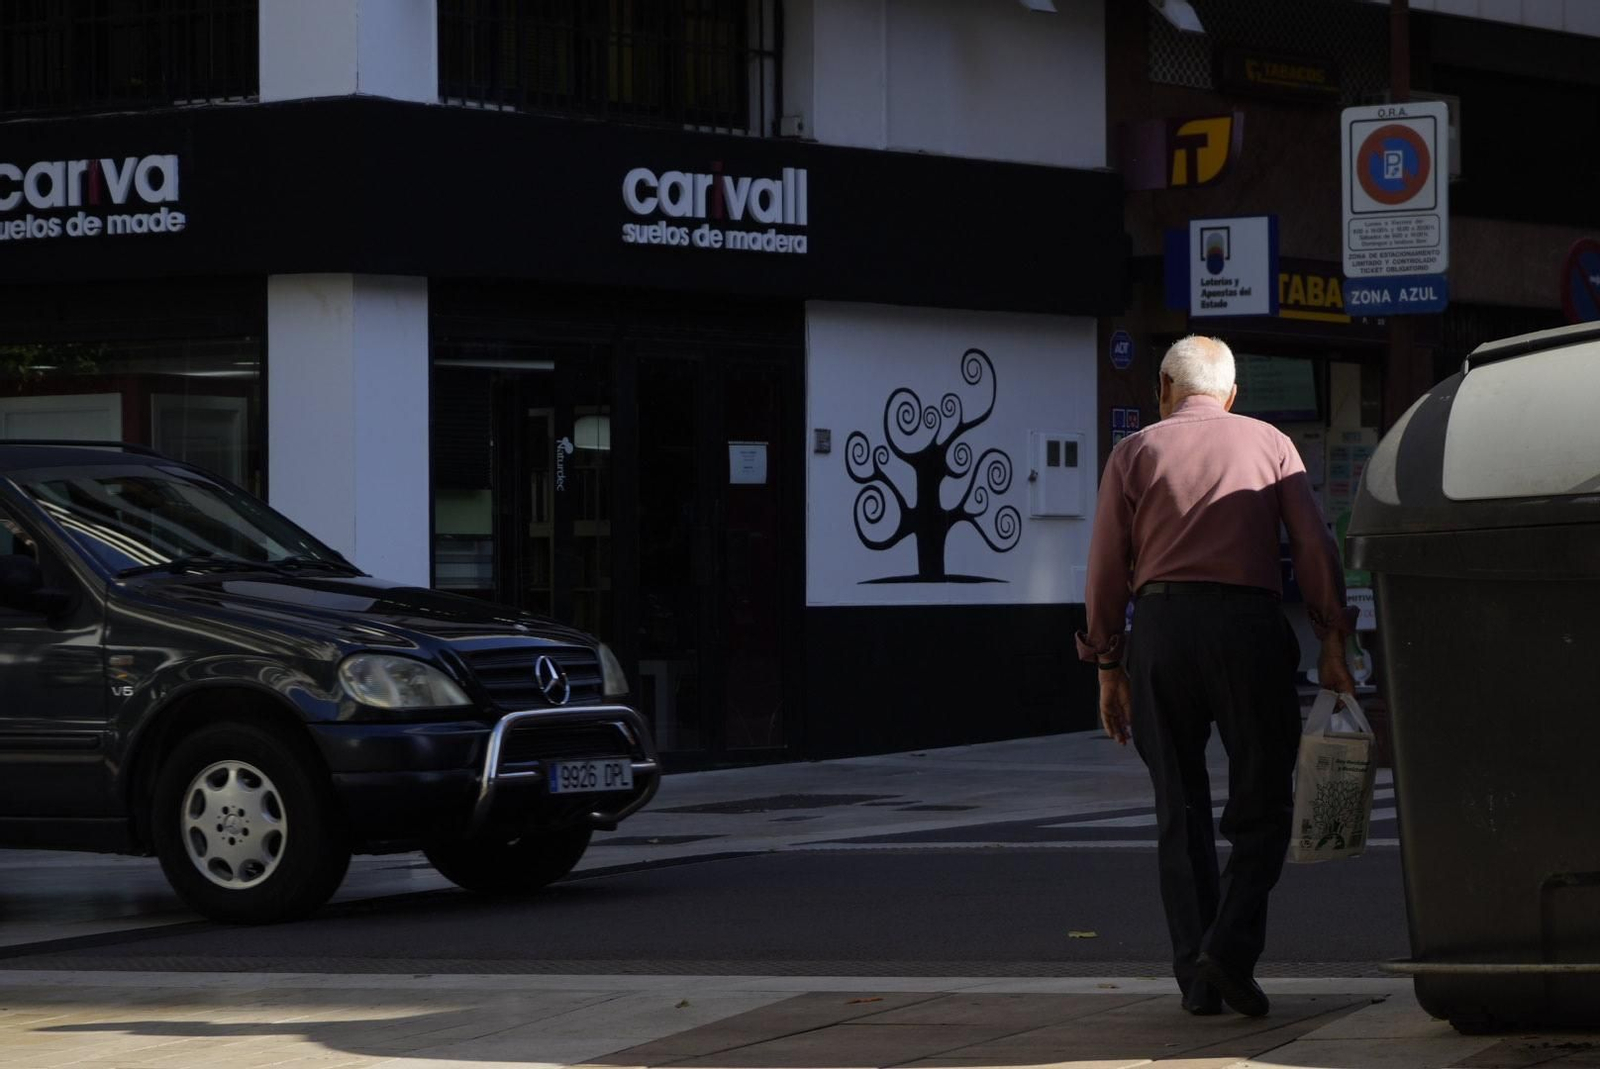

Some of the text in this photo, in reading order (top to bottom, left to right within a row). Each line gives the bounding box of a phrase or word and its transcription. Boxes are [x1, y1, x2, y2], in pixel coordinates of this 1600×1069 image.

[622, 160, 808, 227] carivall
[66, 211, 103, 237] de
[107, 206, 187, 235] made
[622, 220, 808, 256] suelos de madera
[1368, 251, 1379, 259] DE
[1379, 249, 1441, 259] ESTACIONAMIENTO
[1391, 257, 1438, 266] CONTROLADO
[1359, 264, 1430, 274] TICKET OBLIGATORIO
[1233, 277, 1240, 287] y
[1200, 285, 1252, 299] Apuestas del
[1351, 287, 1438, 305] ZONA AZUL
[1200, 298, 1228, 309] Estado
[110, 685, 135, 696] V6
[561, 763, 630, 789] 9926 DPL
